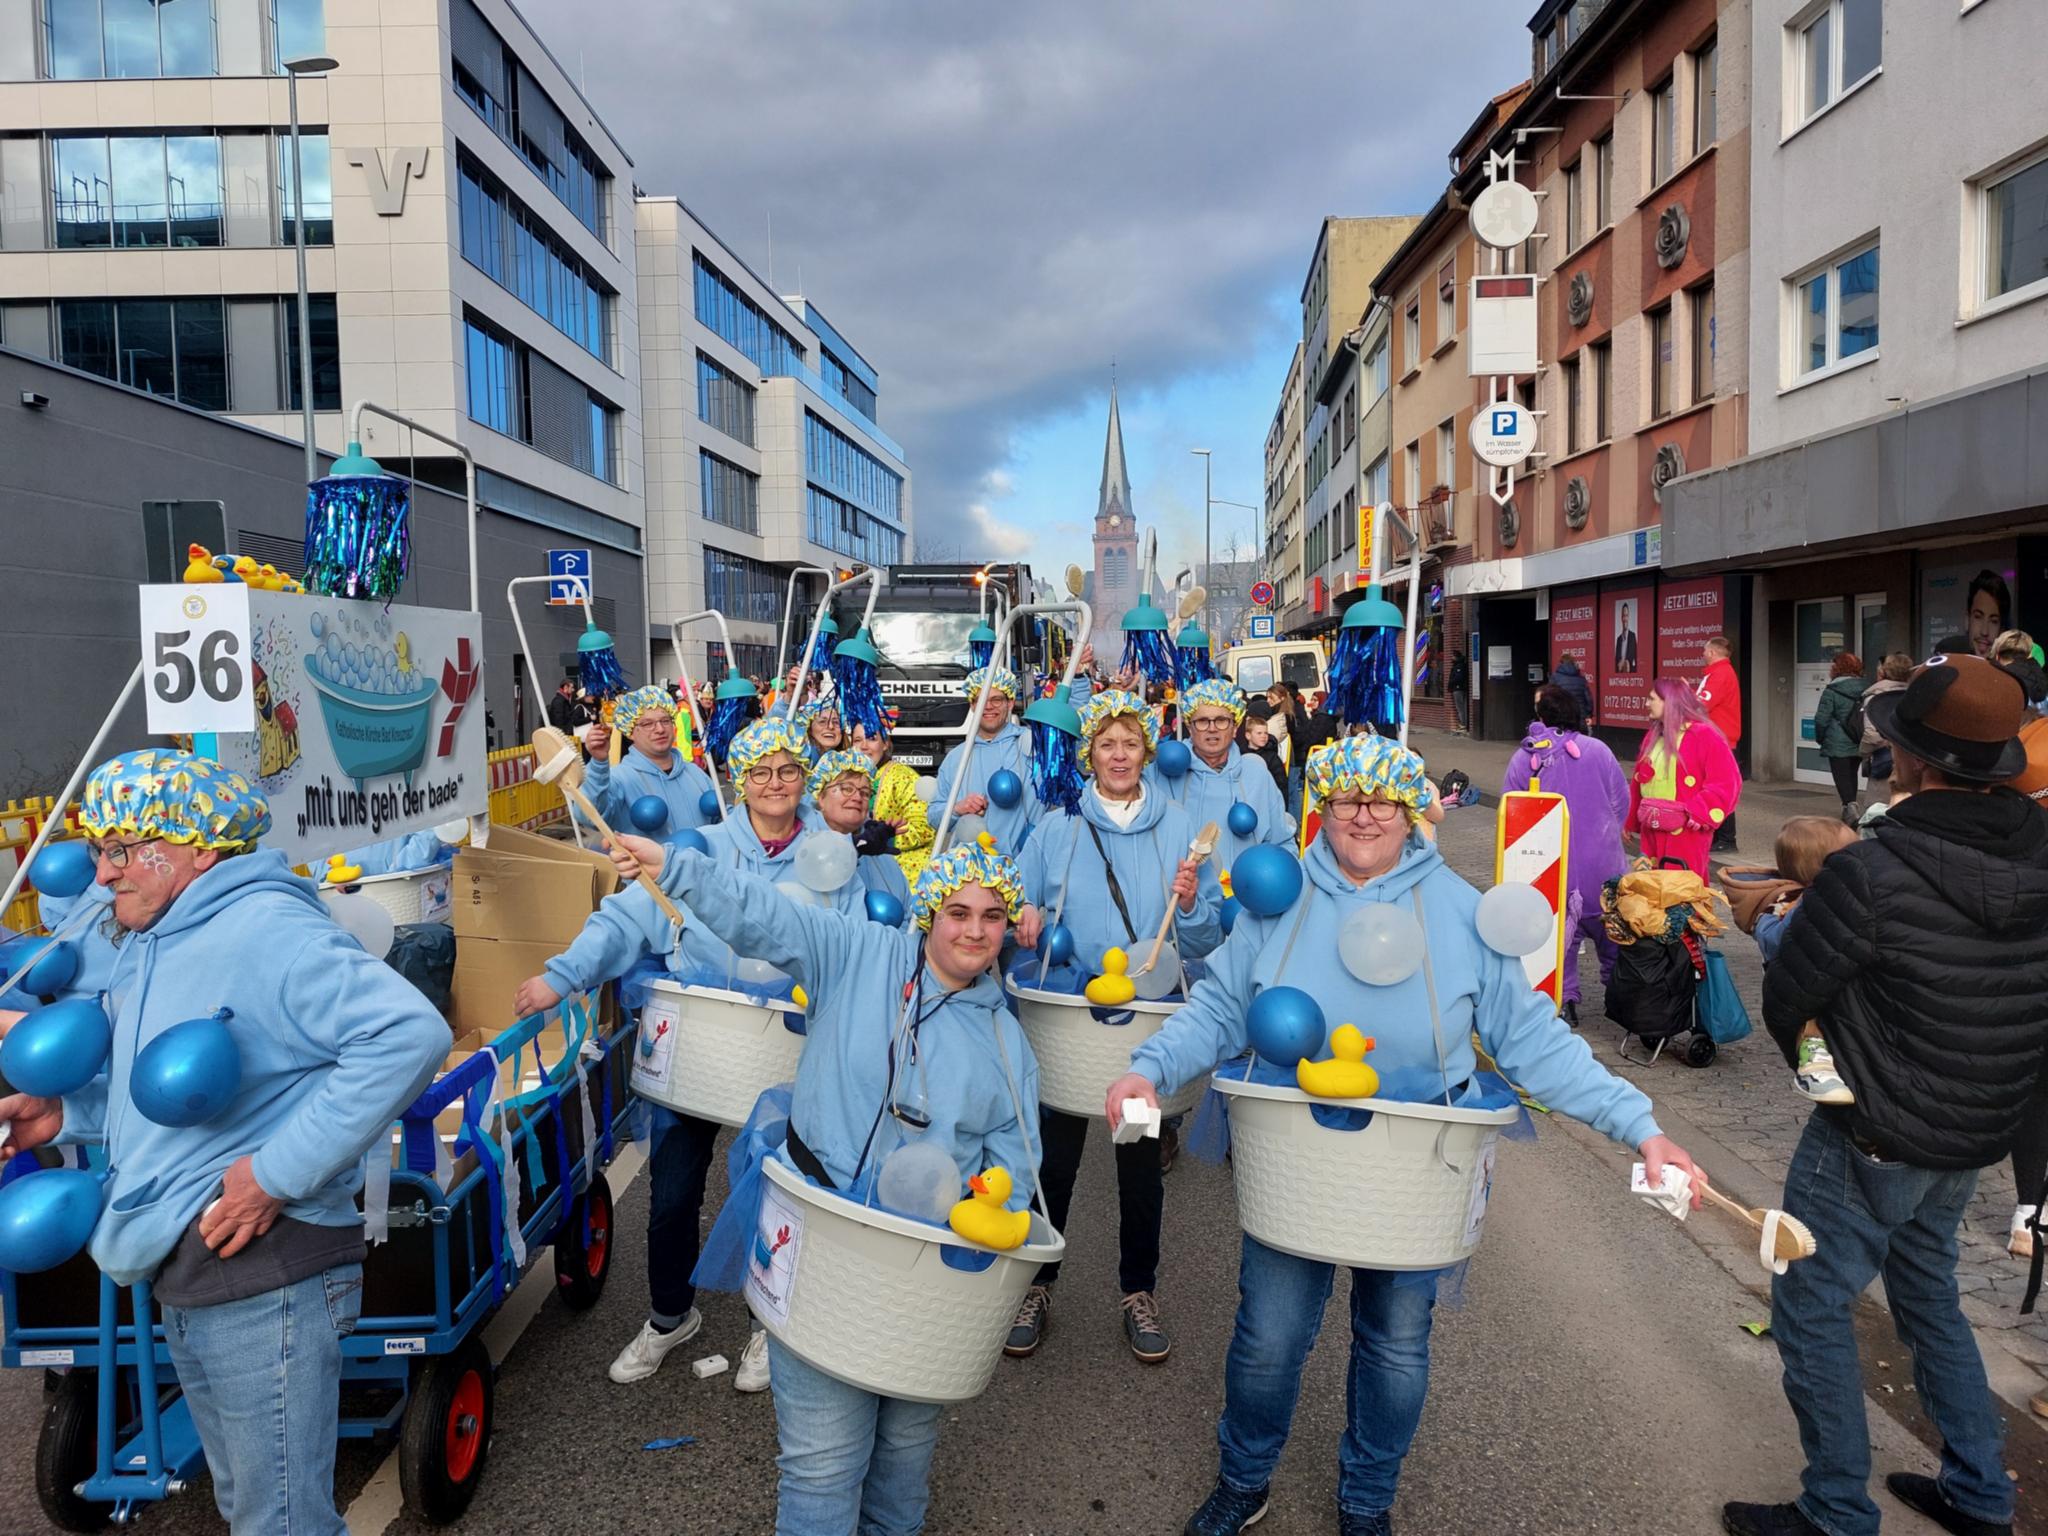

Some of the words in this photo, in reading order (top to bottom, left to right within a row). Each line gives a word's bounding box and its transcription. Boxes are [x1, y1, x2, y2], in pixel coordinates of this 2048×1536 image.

[1497, 414, 1514, 432] P
[1663, 595, 1686, 610] JETZT
[1688, 592, 1718, 607] MIETEN
[1572, 607, 1593, 619] MIETEN
[154, 630, 243, 703] 56
[880, 684, 962, 694] CHNELL-
[338, 789, 367, 827] uns
[387, 1342, 414, 1350] fetra
